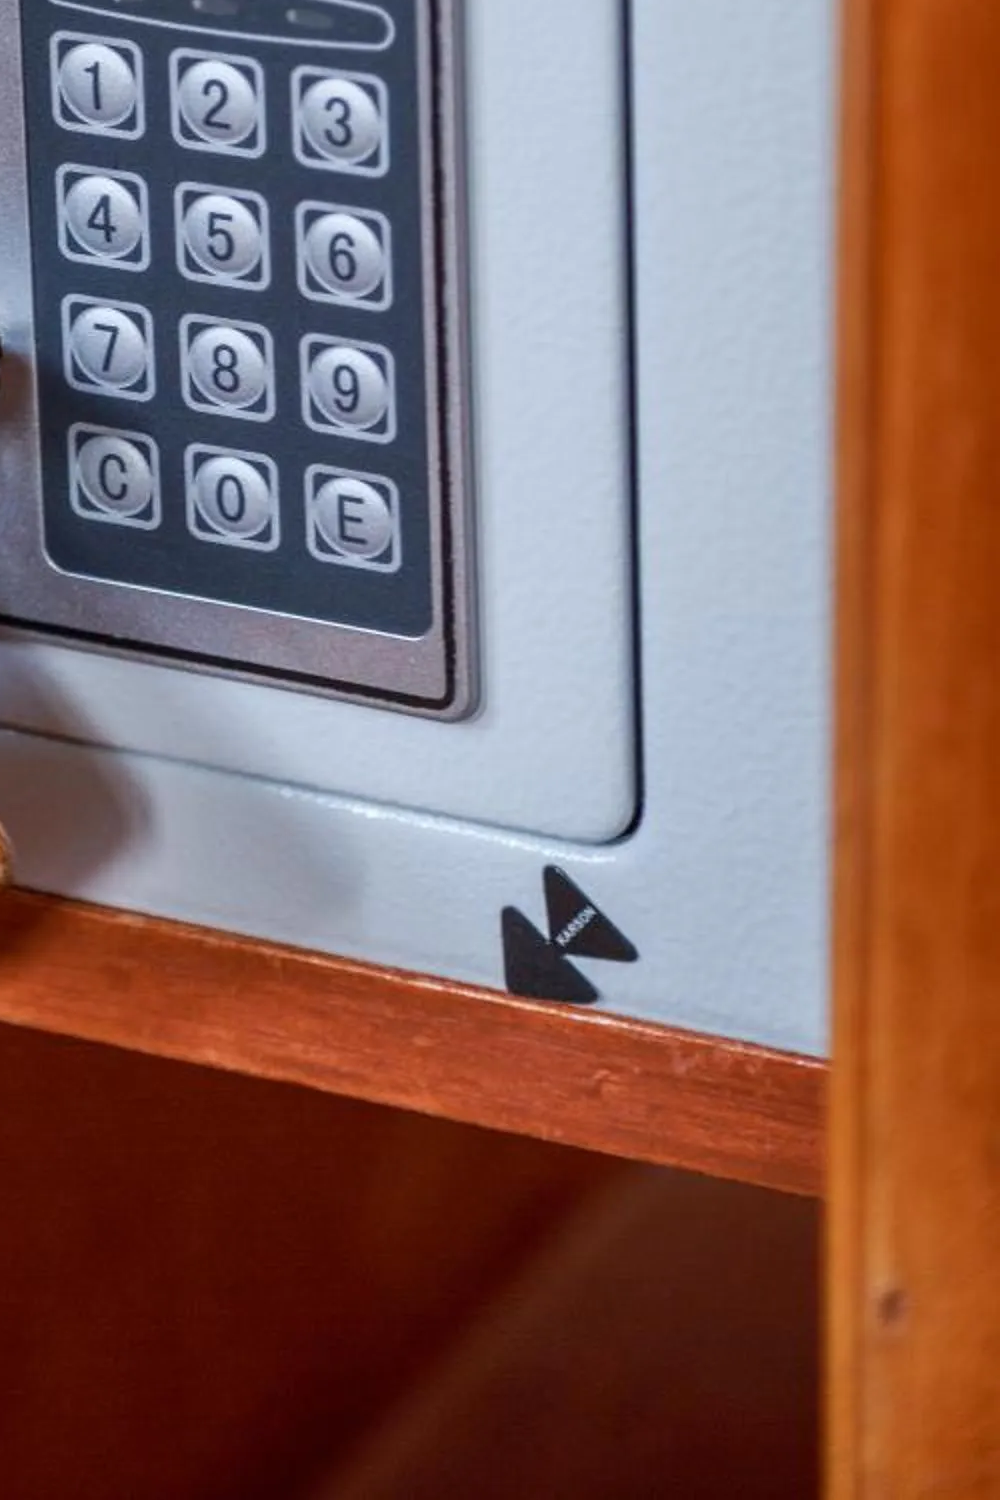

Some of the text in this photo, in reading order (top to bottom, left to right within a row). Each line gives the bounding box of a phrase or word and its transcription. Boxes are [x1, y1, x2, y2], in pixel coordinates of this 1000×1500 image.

[84, 62, 352, 149] 1 2 3
[87, 195, 356, 282] 4 5 6
[92, 324, 360, 413] 7 8 9
[99, 454, 367, 545] C 0 E
